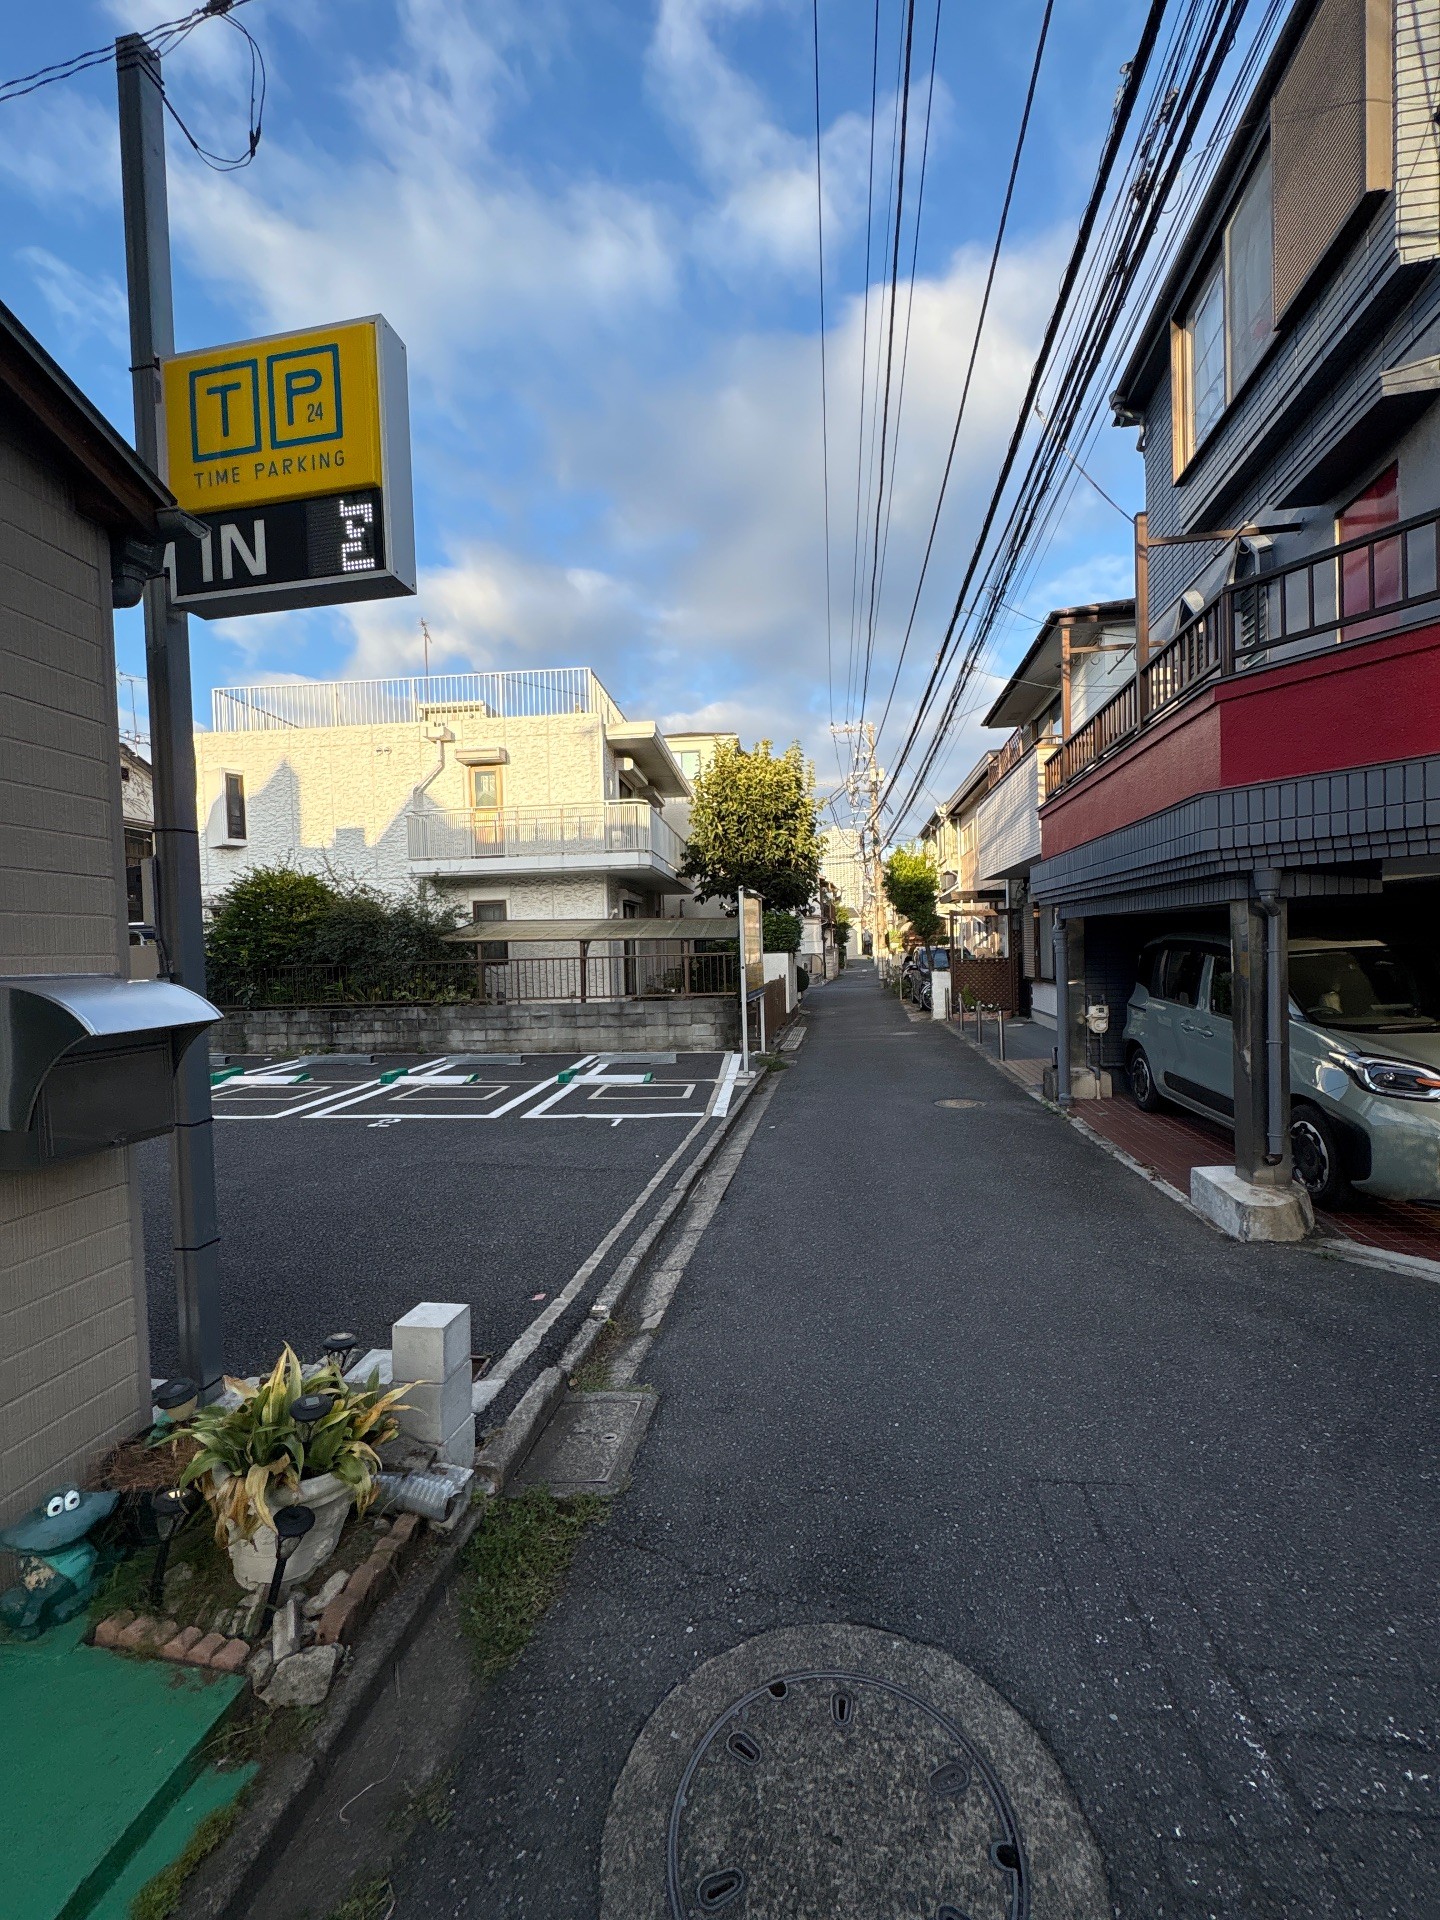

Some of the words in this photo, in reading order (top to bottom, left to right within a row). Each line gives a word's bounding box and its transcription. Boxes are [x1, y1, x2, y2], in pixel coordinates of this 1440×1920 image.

[306, 402, 324, 423] 24
[194, 466, 241, 489] TIME
[254, 450, 345, 480] PARKING
[366, 1118, 402, 1128] 2
